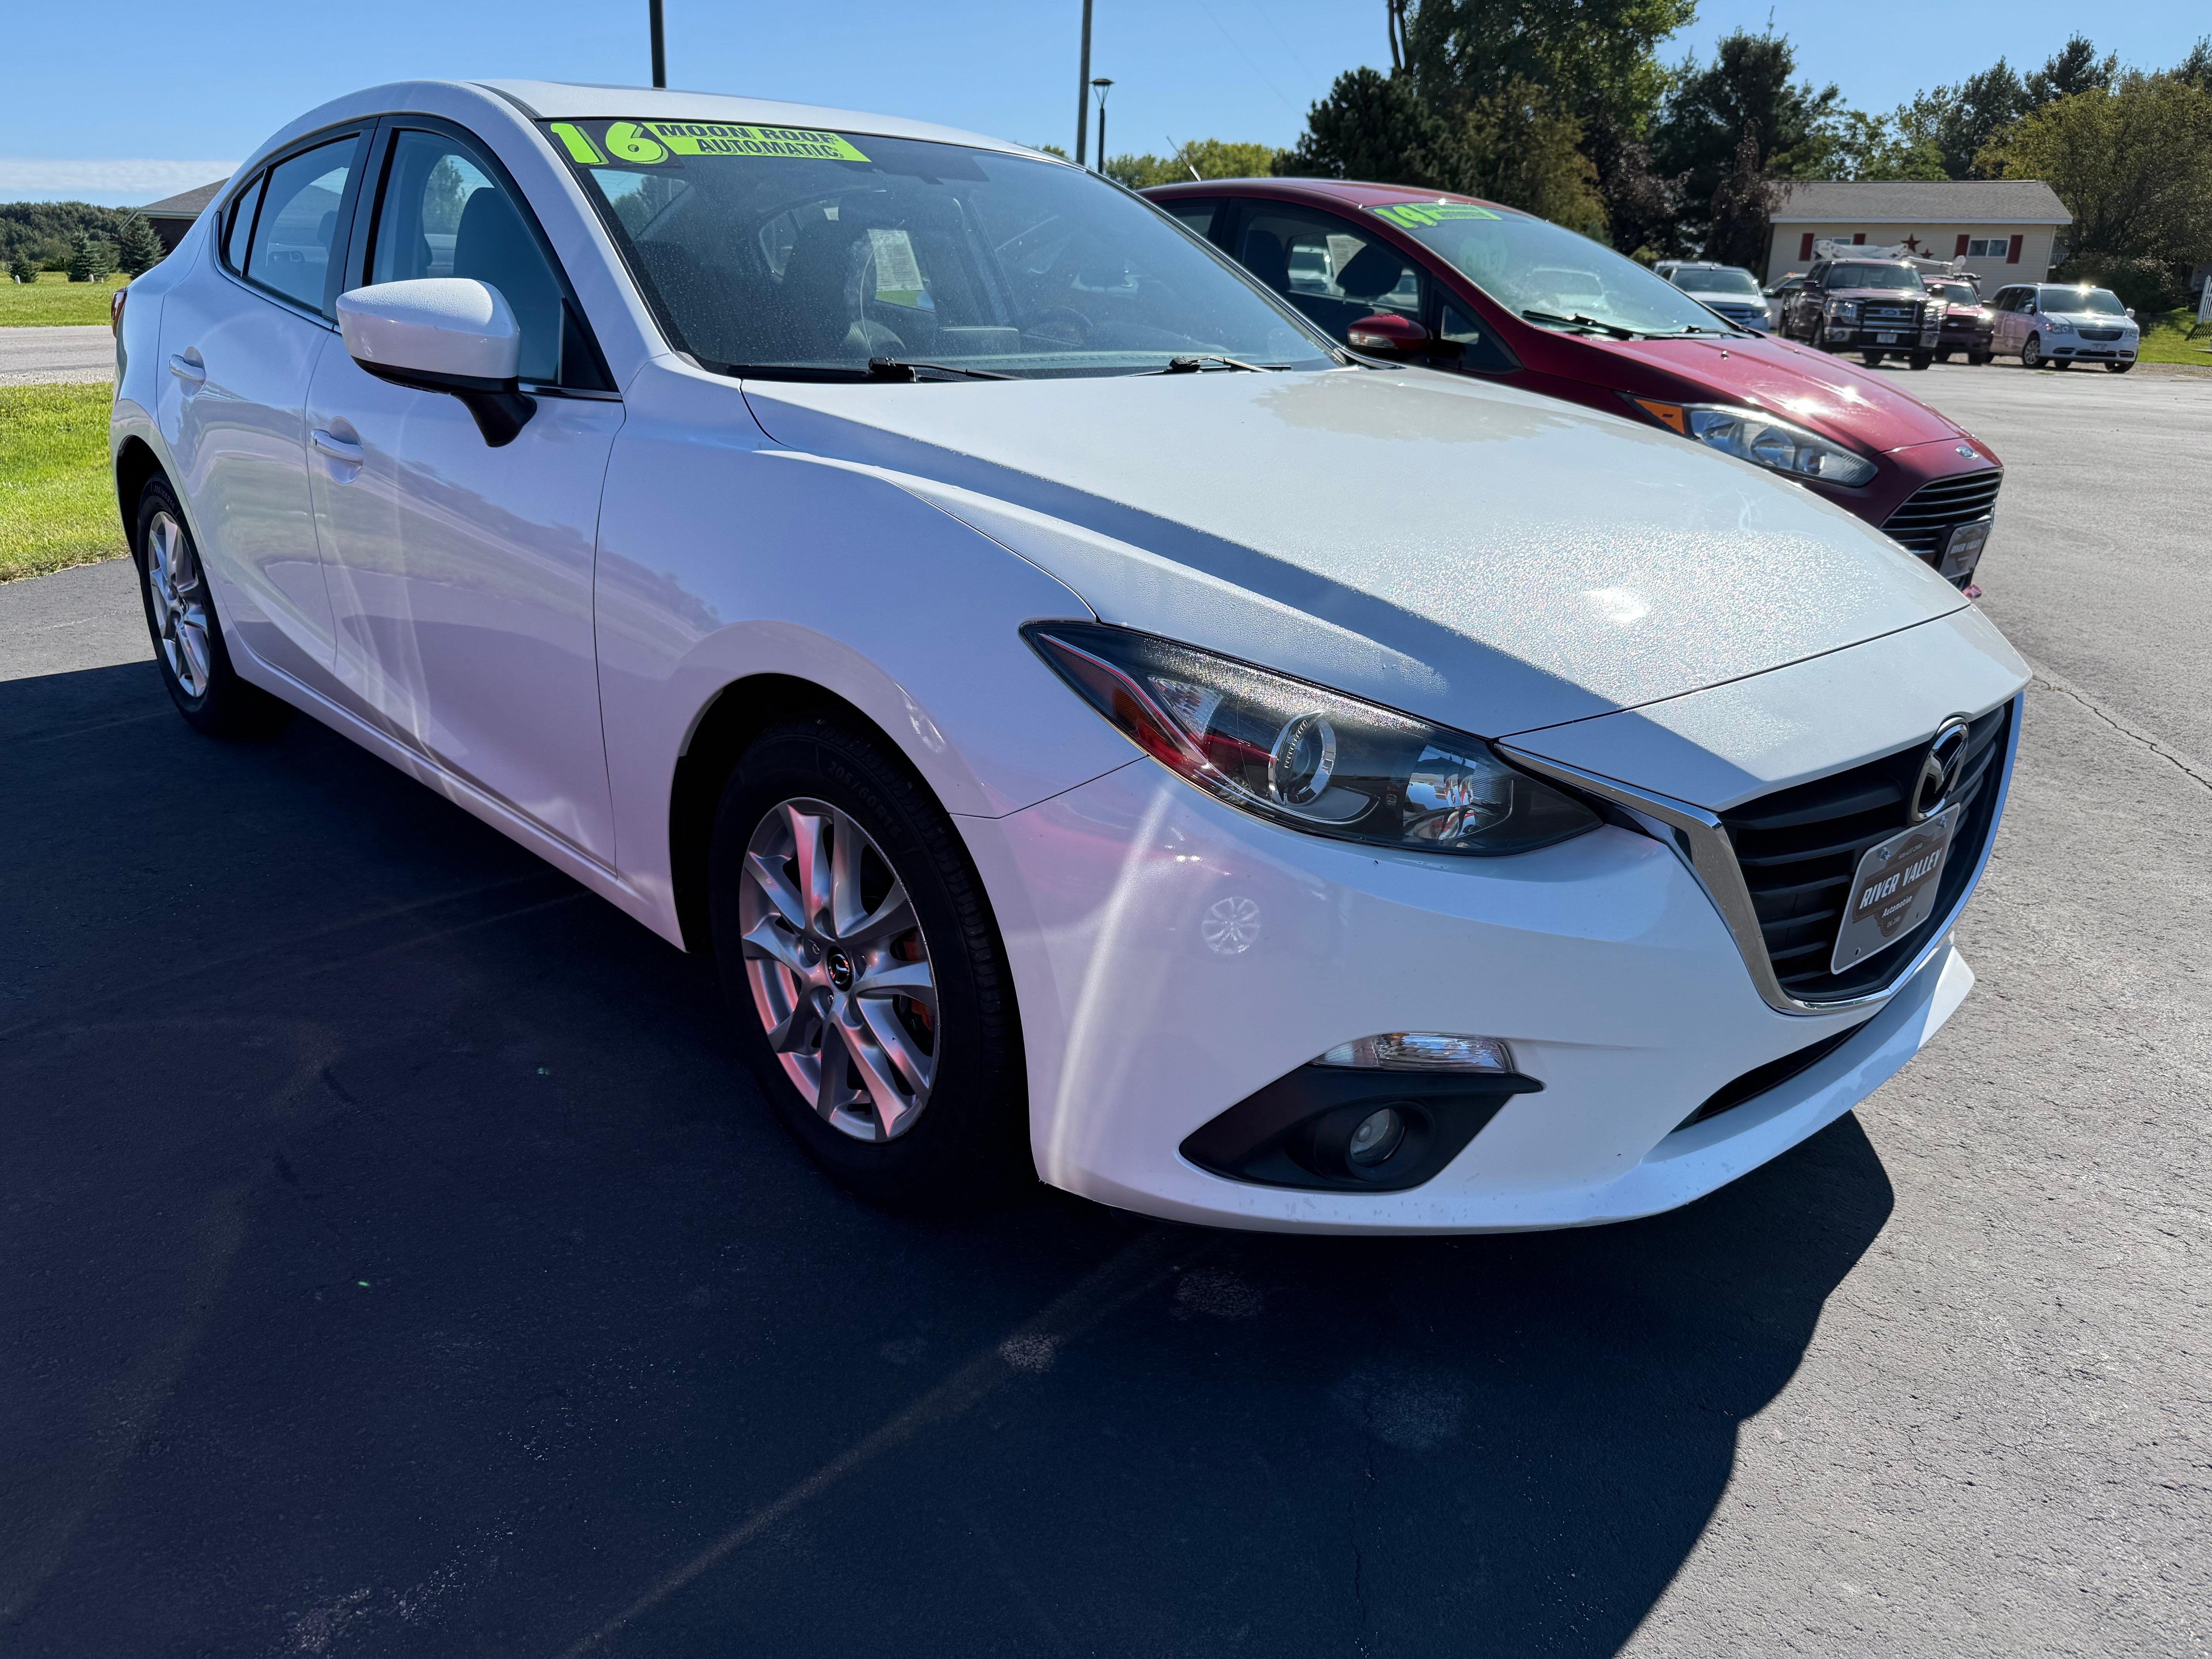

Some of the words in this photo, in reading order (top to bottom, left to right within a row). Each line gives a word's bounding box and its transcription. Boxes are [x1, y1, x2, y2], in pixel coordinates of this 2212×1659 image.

[550, 122, 668, 165] 16
[654, 124, 753, 141] MOON
[760, 129, 840, 144] ROOF
[696, 139, 843, 158] AUTOMATIC
[828, 761, 901, 837] 205/60R16
[1859, 872, 1900, 910] RIVER
[1902, 847, 1942, 886] VALLEY
[1882, 895, 1913, 918] Automotive
